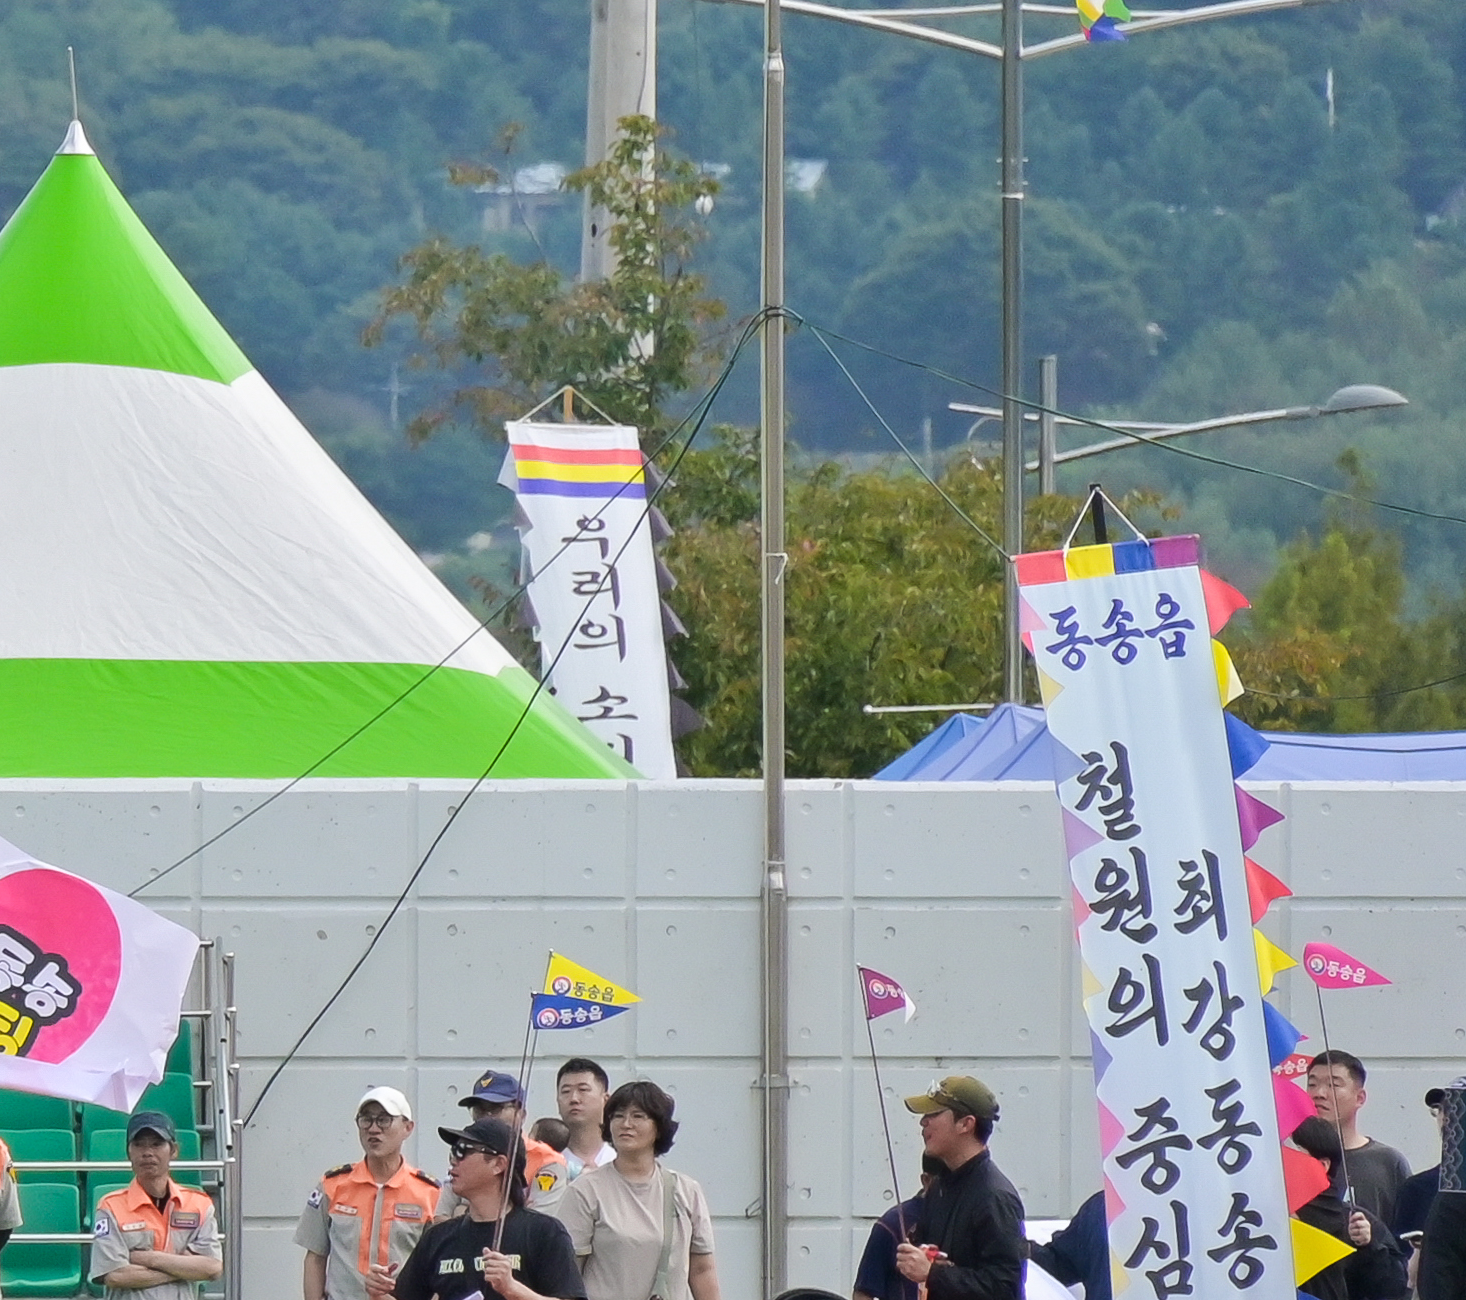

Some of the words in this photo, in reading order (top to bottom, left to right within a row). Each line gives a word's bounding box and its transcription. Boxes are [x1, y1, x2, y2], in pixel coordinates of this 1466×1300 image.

[1045, 592, 1195, 671] 동송읍
[1074, 741, 1168, 1046] 철원의
[1328, 961, 1366, 984] 동송읍
[574, 981, 614, 1002] 동송읍
[559, 1005, 603, 1025] 동송읍
